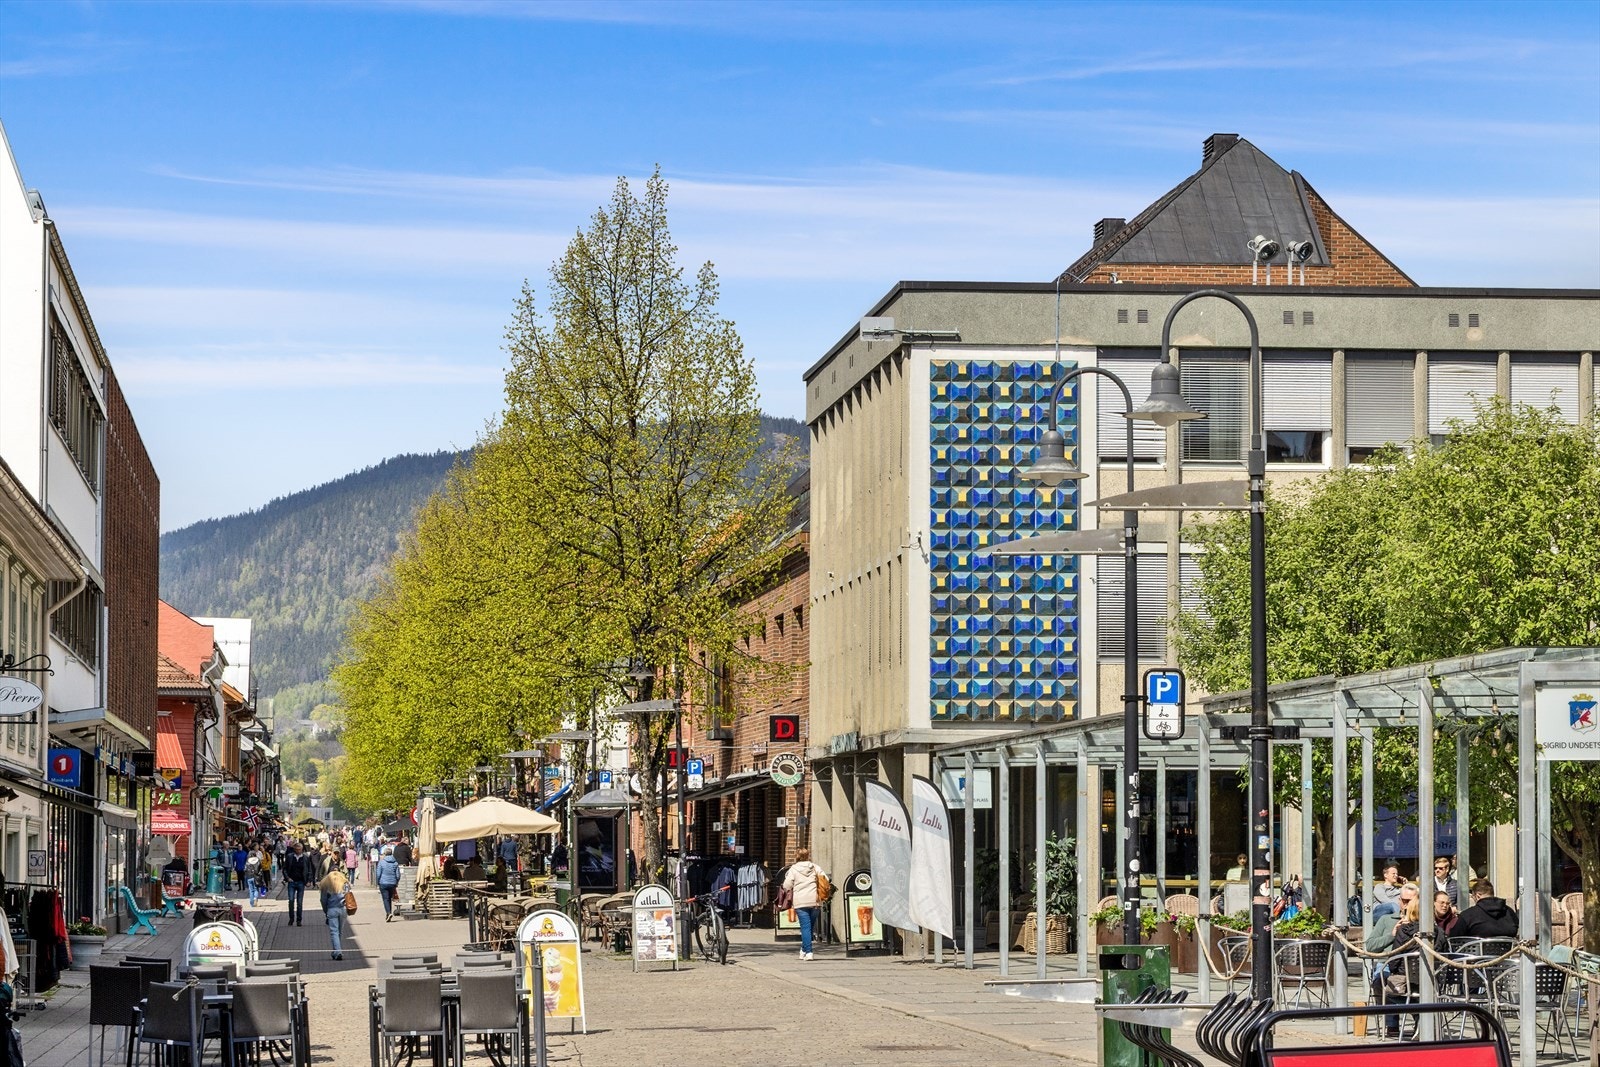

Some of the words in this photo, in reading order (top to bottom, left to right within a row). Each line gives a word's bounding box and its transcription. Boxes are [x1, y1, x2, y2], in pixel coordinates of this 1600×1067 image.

[0, 686, 40, 703] Pierre
[1156, 678, 1172, 700] P
[775, 719, 795, 738] D
[1543, 741, 1567, 749] SIGRID
[1568, 741, 1600, 749] UNDSETS
[59, 758, 67, 771] 1
[690, 763, 699, 773] P
[772, 754, 802, 769] ESPRESSO
[602, 773, 609, 781] P
